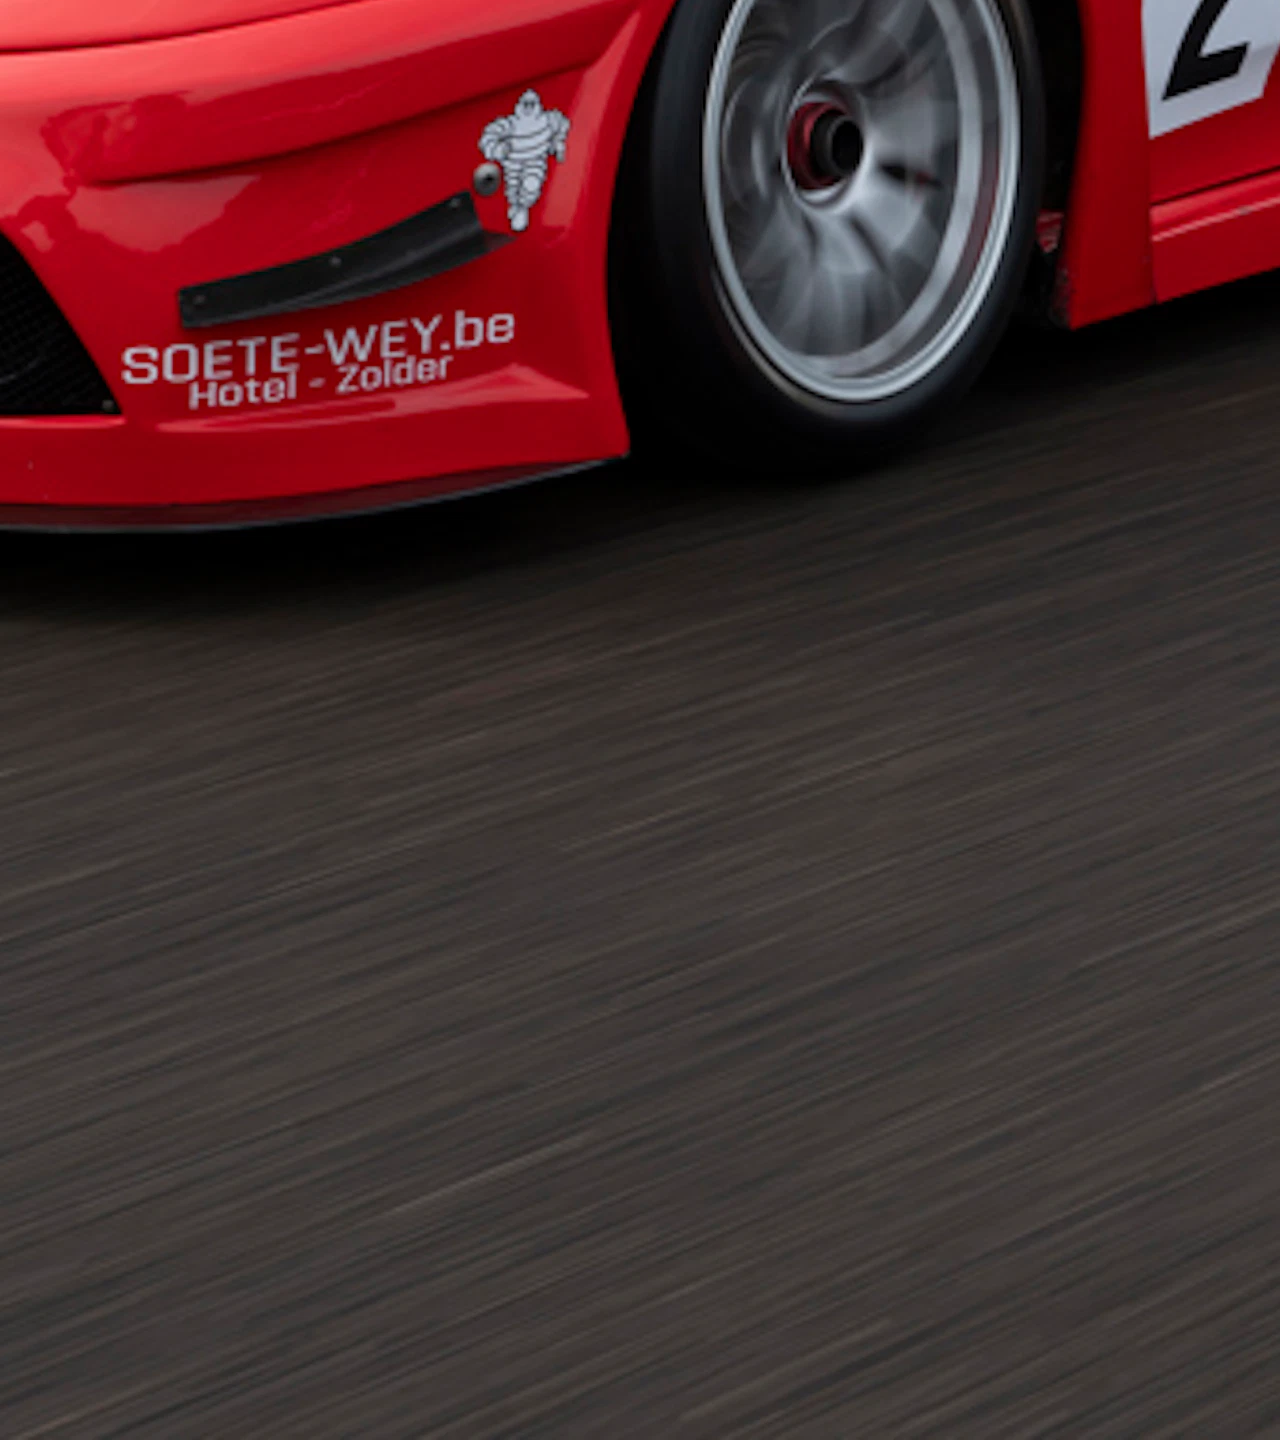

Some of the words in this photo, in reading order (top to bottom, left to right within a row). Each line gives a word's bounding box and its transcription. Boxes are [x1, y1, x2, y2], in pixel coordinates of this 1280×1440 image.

[120, 309, 516, 385] SOETE-WEY.be
[187, 371, 297, 411] Hotel
[336, 354, 454, 394] Zolder
